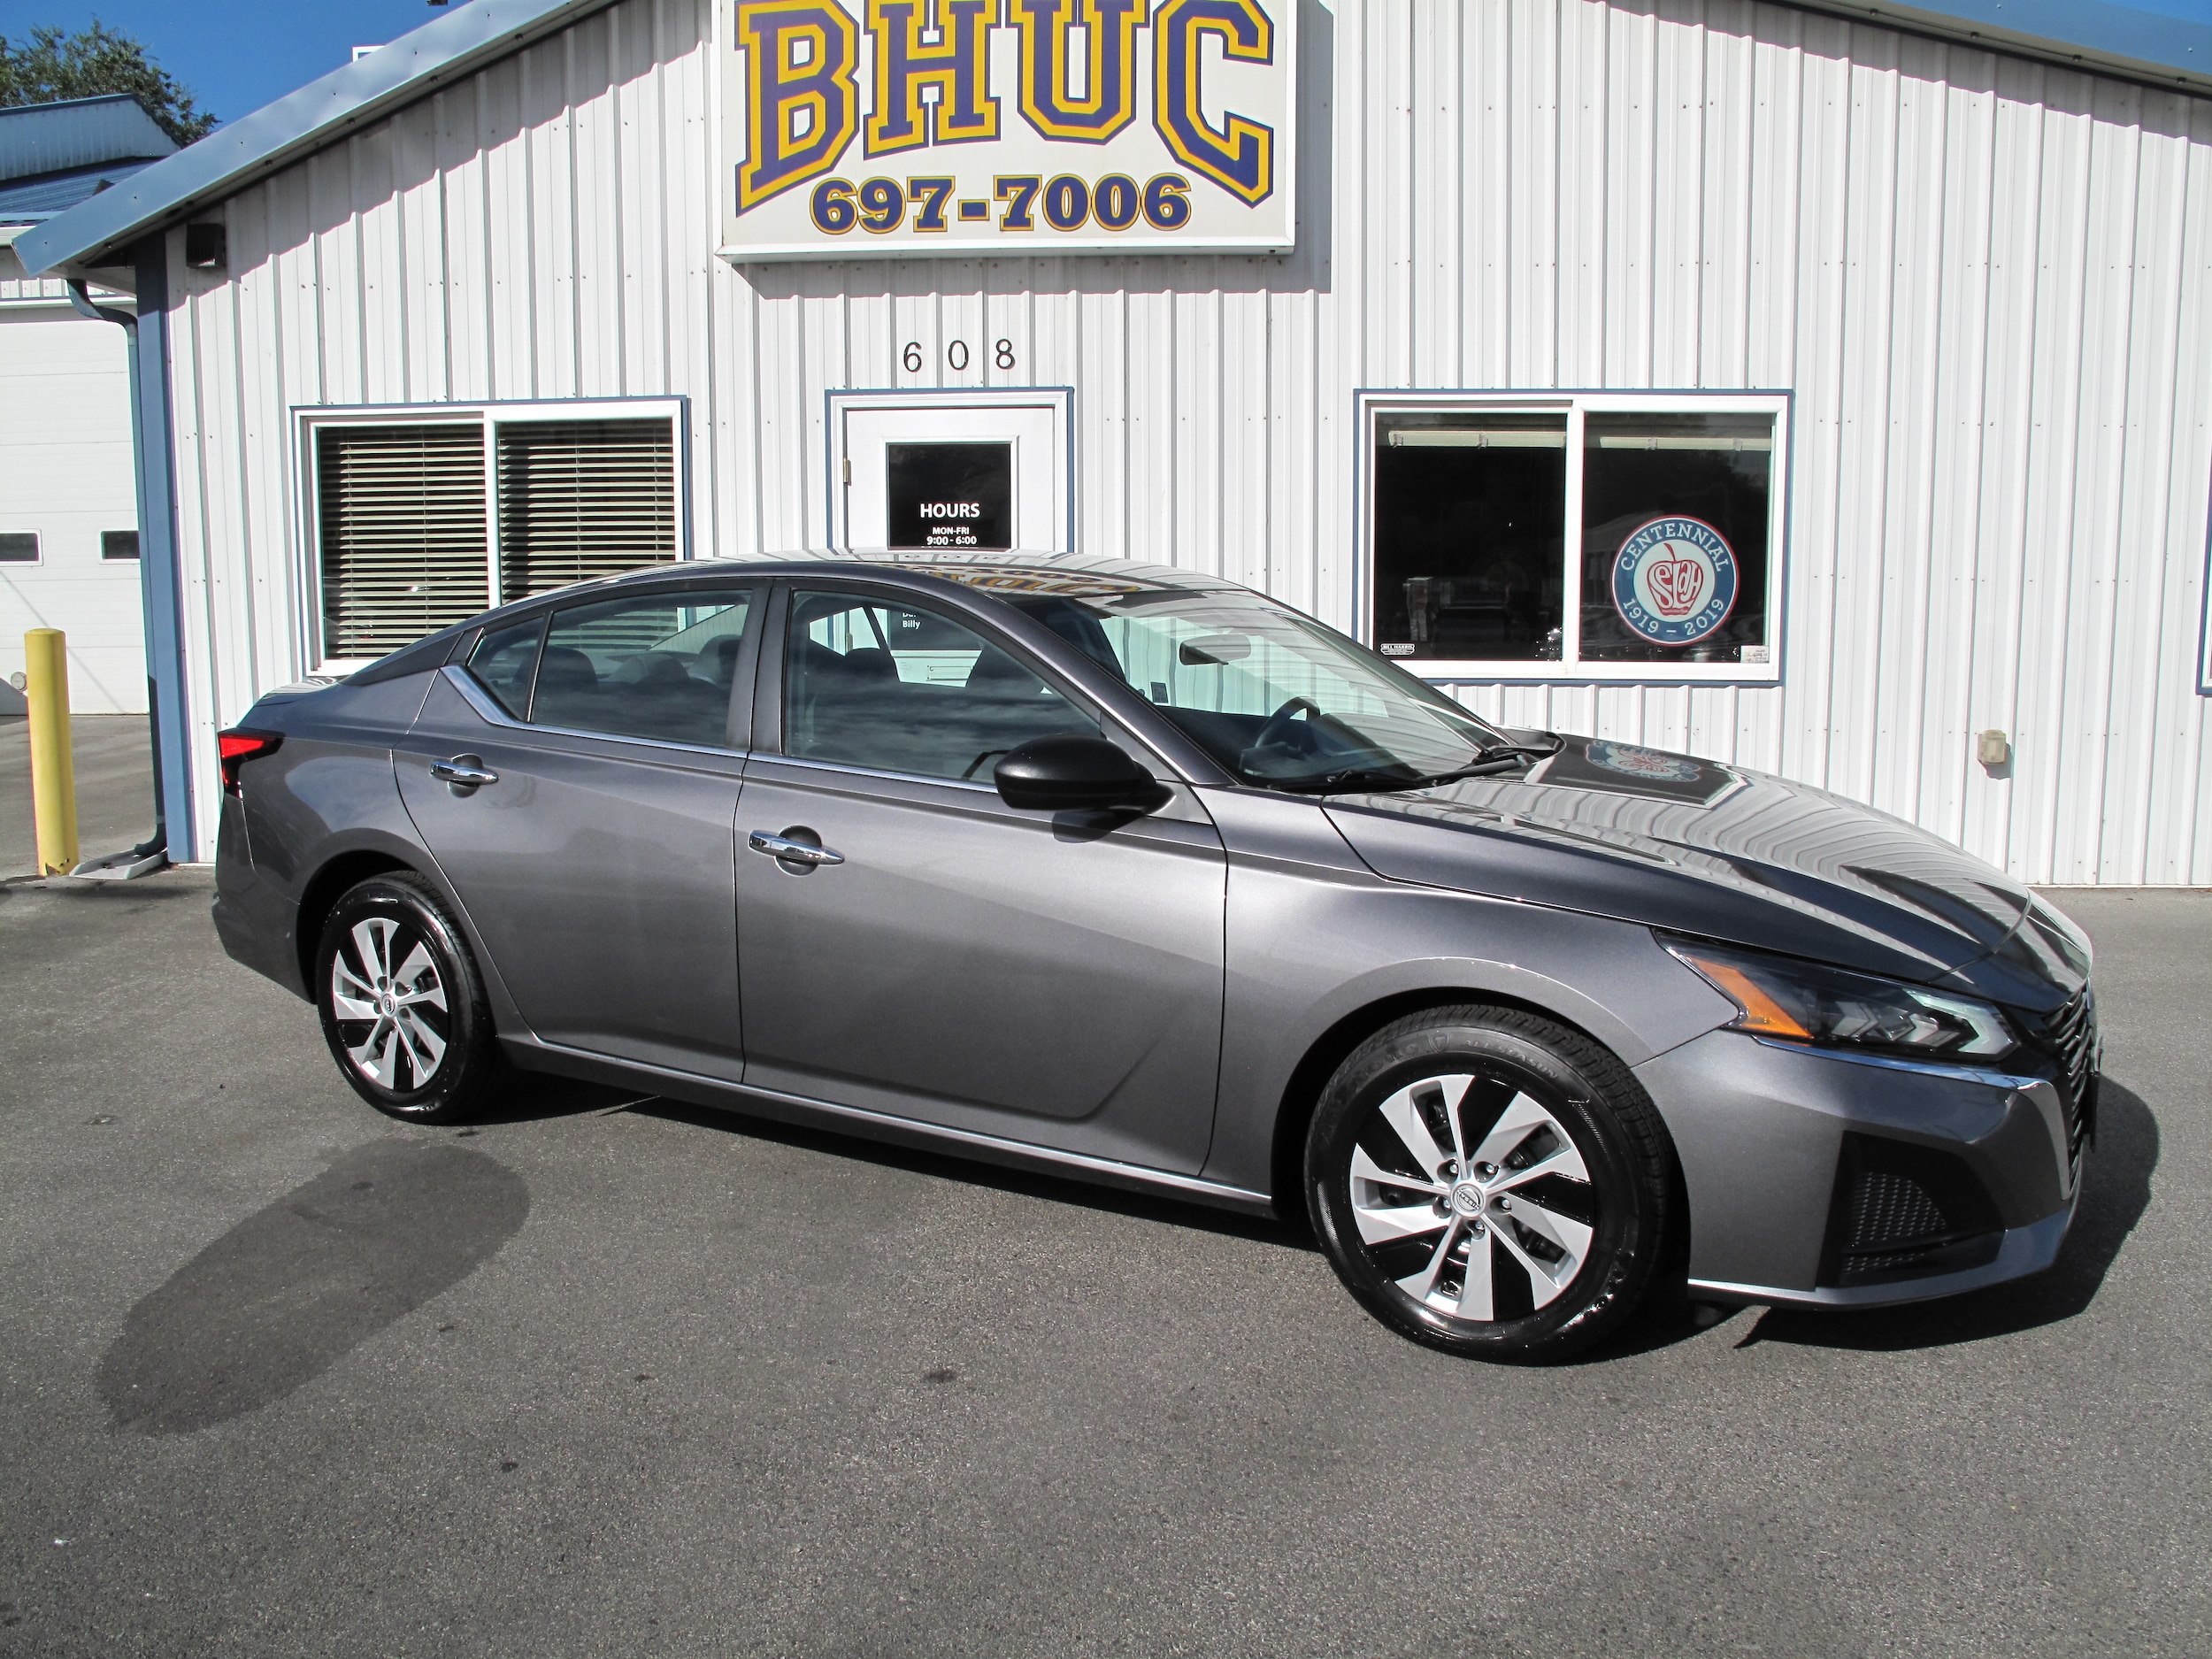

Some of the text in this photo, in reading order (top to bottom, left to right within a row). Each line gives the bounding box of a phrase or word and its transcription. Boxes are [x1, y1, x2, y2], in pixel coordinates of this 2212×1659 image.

[736, 0, 1274, 218] BHUC
[809, 173, 1192, 234] 697-7006
[902, 338, 1016, 373] 608
[920, 503, 980, 518] HOURS
[926, 535, 949, 546] 9:00
[955, 535, 977, 545] 6:00
[932, 526, 970, 535] MON-FRI
[1621, 523, 1729, 572] CENTENNIAL
[902, 619, 920, 629] Billy
[1623, 598, 1659, 634] 1919
[1685, 599, 1724, 636] 2019
